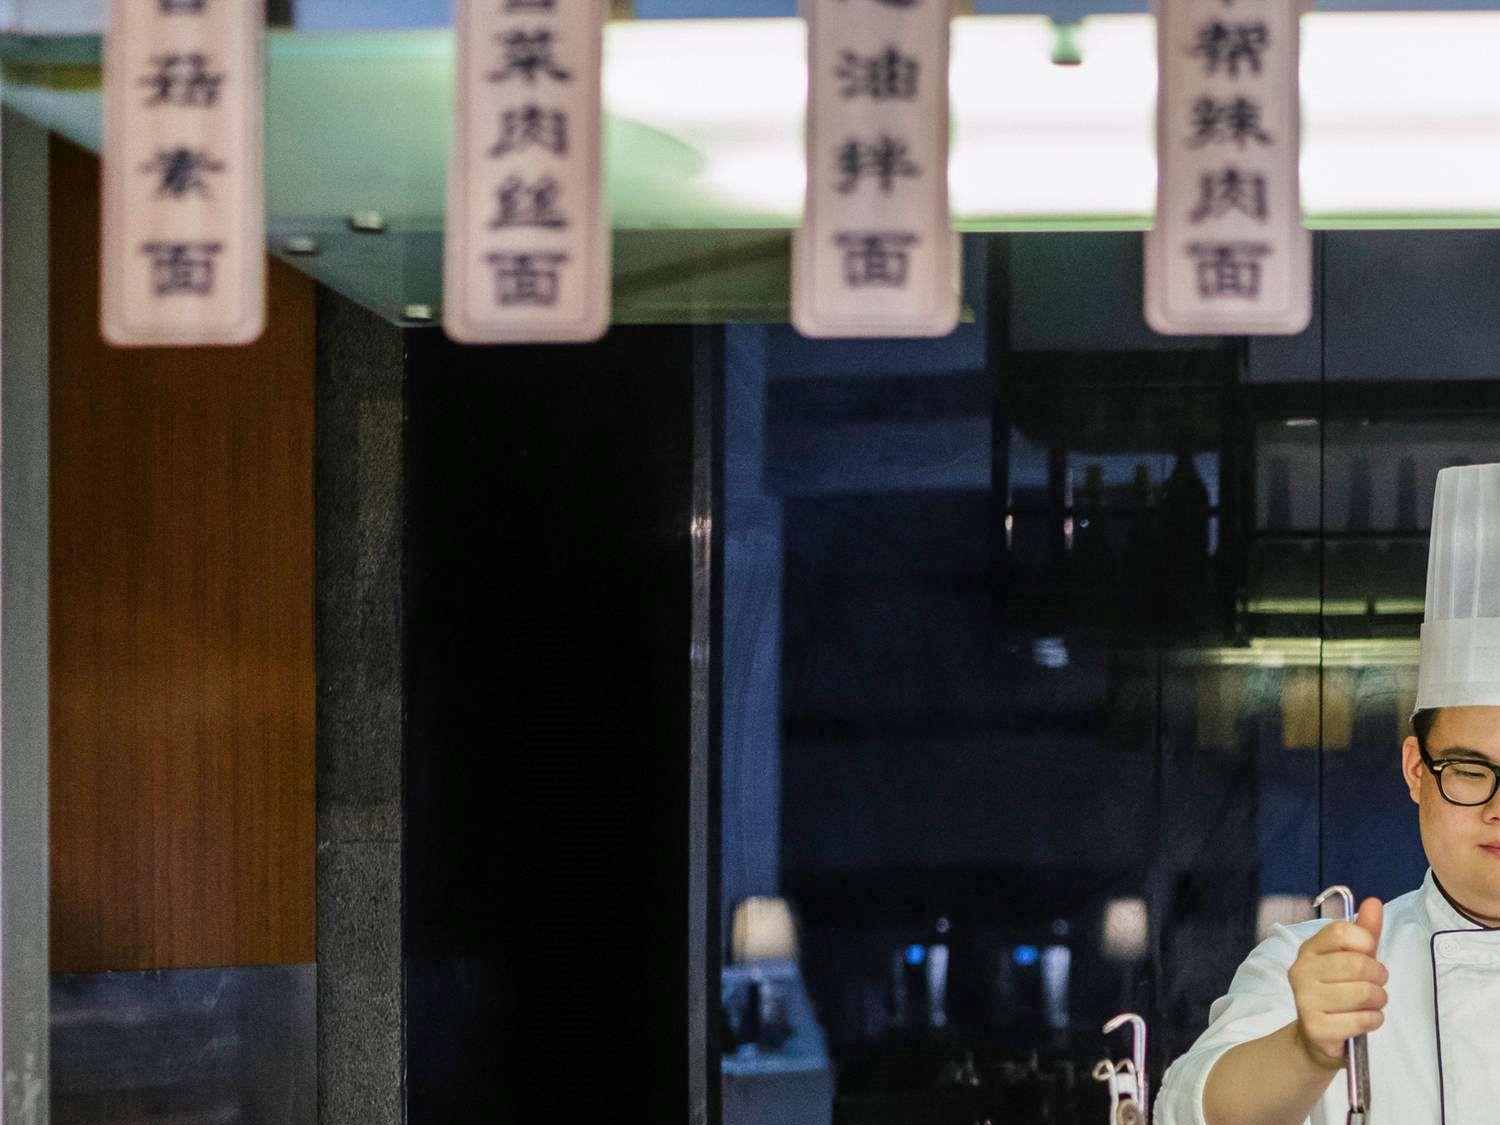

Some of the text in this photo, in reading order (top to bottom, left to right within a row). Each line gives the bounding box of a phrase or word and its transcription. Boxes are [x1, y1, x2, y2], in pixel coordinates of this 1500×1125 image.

[140, 0, 224, 298] 菇素面
[489, 0, 572, 306] 菜肉丝面
[837, 0, 919, 283] 油拌面
[1190, 0, 1269, 293] 帮辣肉面
